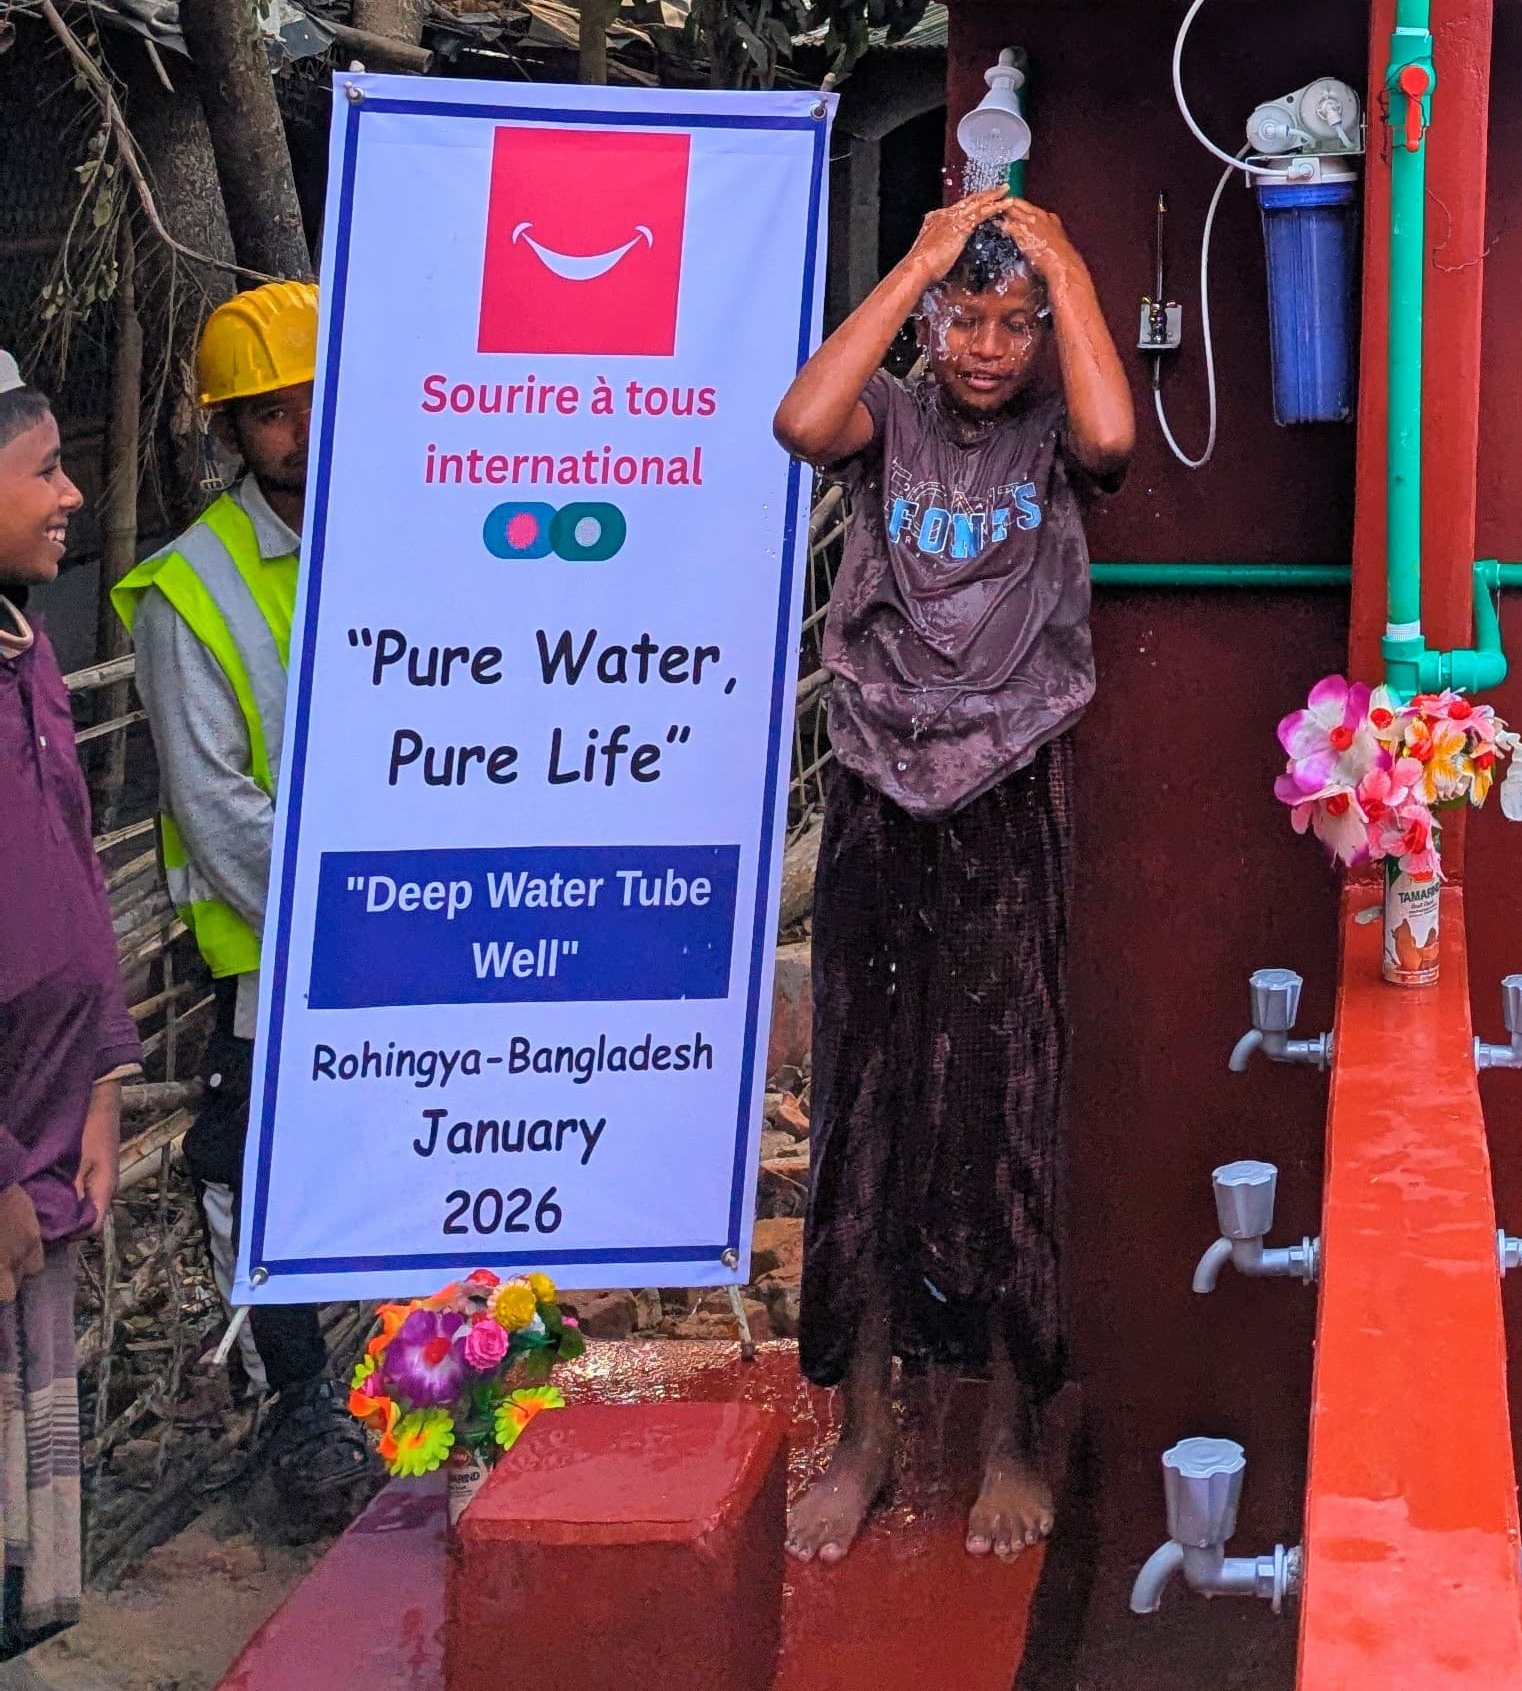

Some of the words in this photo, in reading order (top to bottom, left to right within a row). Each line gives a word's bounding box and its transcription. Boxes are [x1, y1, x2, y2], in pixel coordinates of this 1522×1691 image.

[421, 374, 579, 415] Sourire
[590, 375, 614, 415] à
[625, 381, 716, 416] tous
[425, 443, 703, 486] international
[347, 627, 503, 687] “Pure
[535, 628, 737, 695] Water,
[388, 728, 518, 787] Pure
[547, 724, 691, 787] Life”
[347, 875, 473, 920] "Deep
[486, 871, 605, 909] Water
[615, 868, 712, 907] Tube
[472, 938, 579, 979] Well"
[312, 1031, 713, 1089] Rohingya-Bangladesh
[412, 1108, 607, 1166] January
[442, 1186, 562, 1235] 2026
